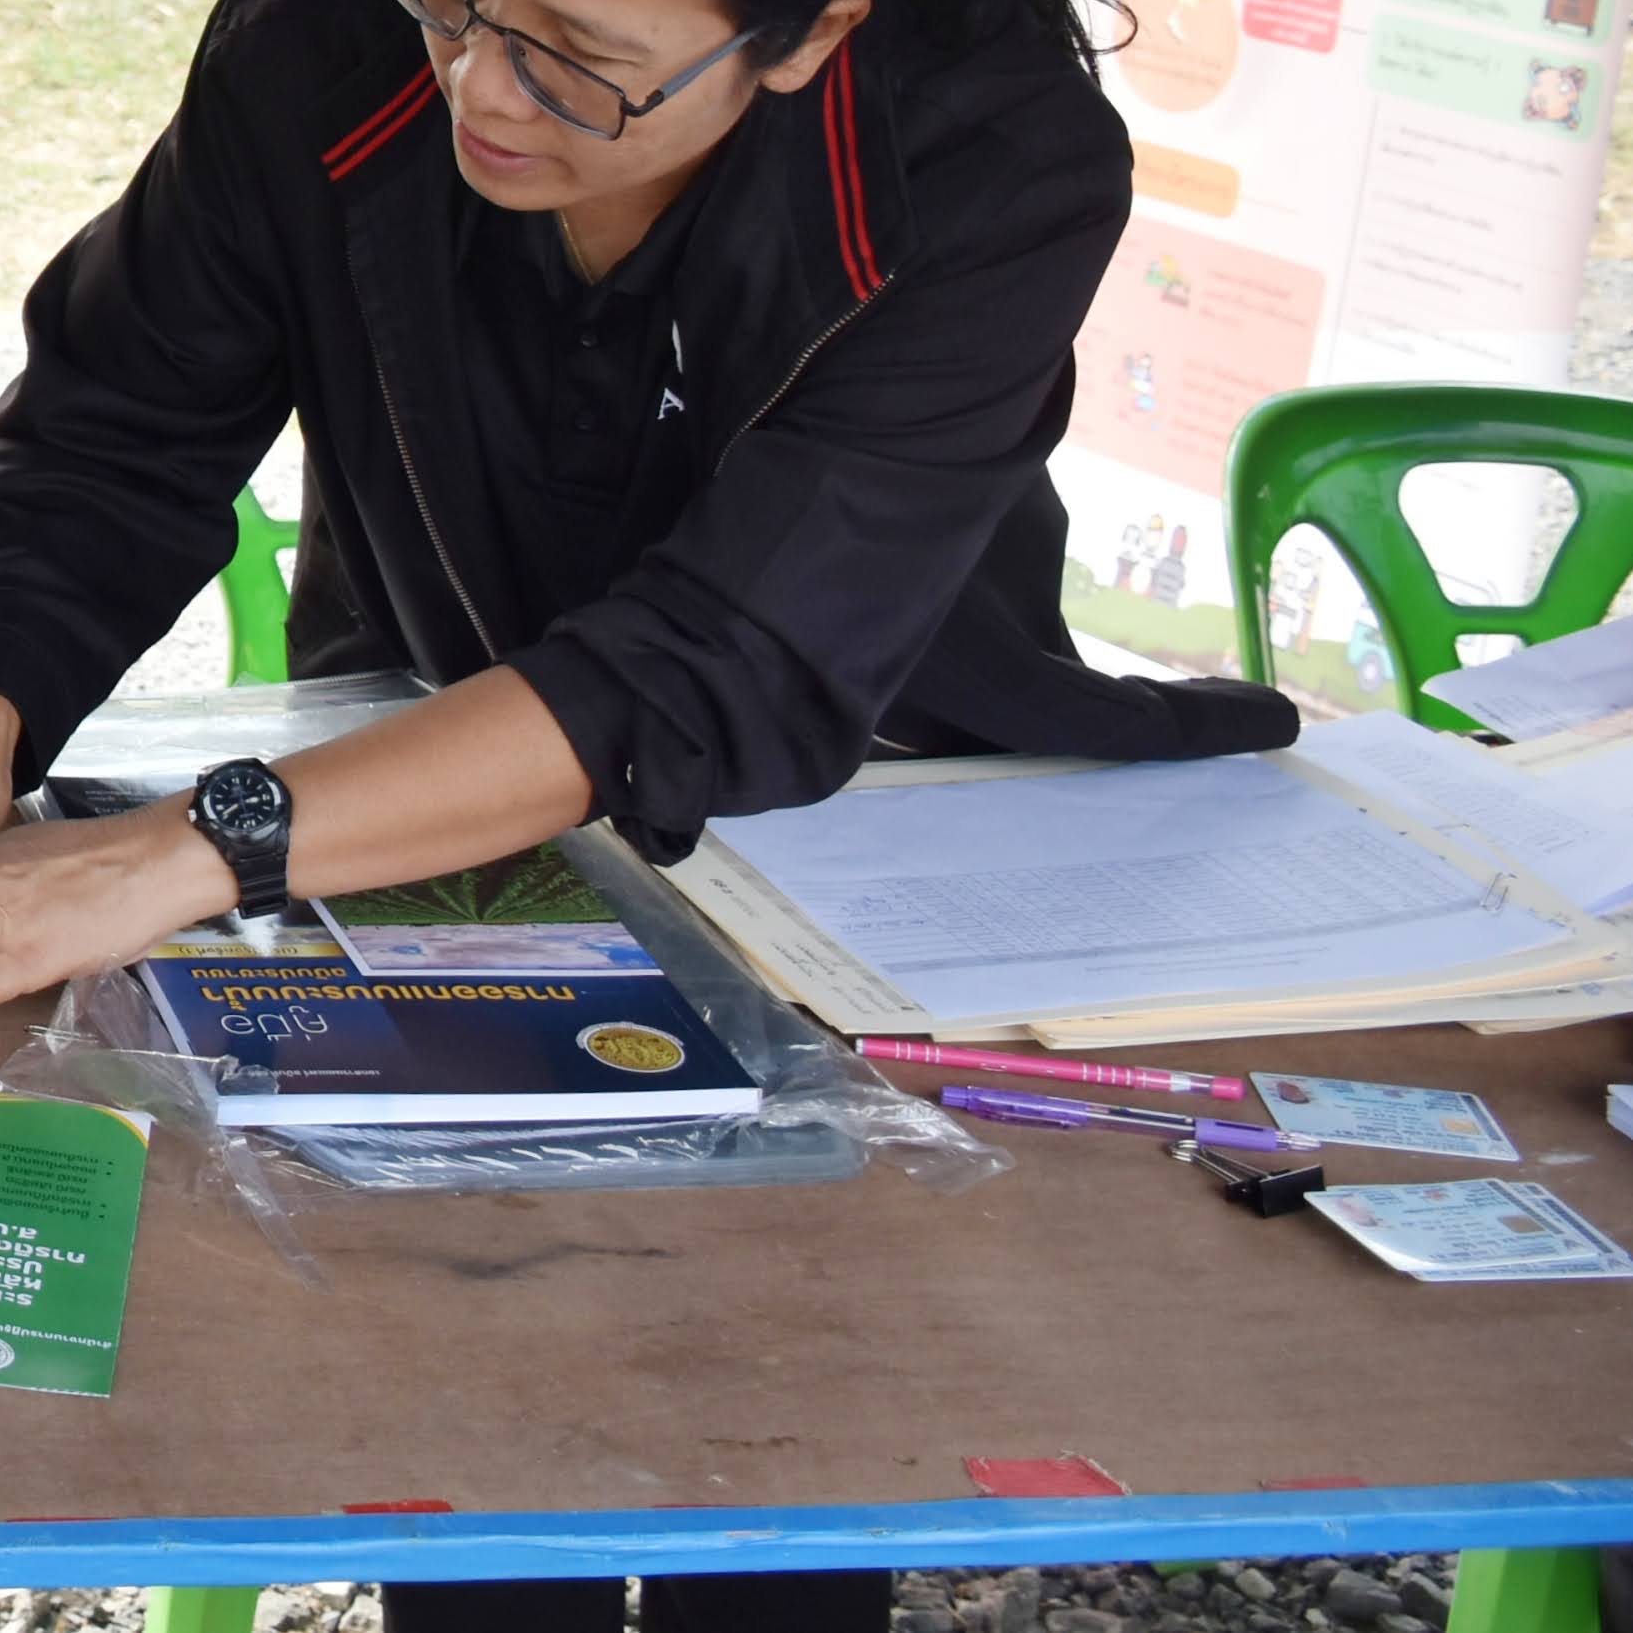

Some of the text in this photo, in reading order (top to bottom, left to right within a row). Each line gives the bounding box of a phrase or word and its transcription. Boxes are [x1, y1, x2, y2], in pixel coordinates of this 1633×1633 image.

[191, 966, 347, 980] ฉบับประชาชน
[202, 985, 575, 1013] การออกแบบระบบน้ำ
[220, 1006, 328, 1042] คู่มือ
